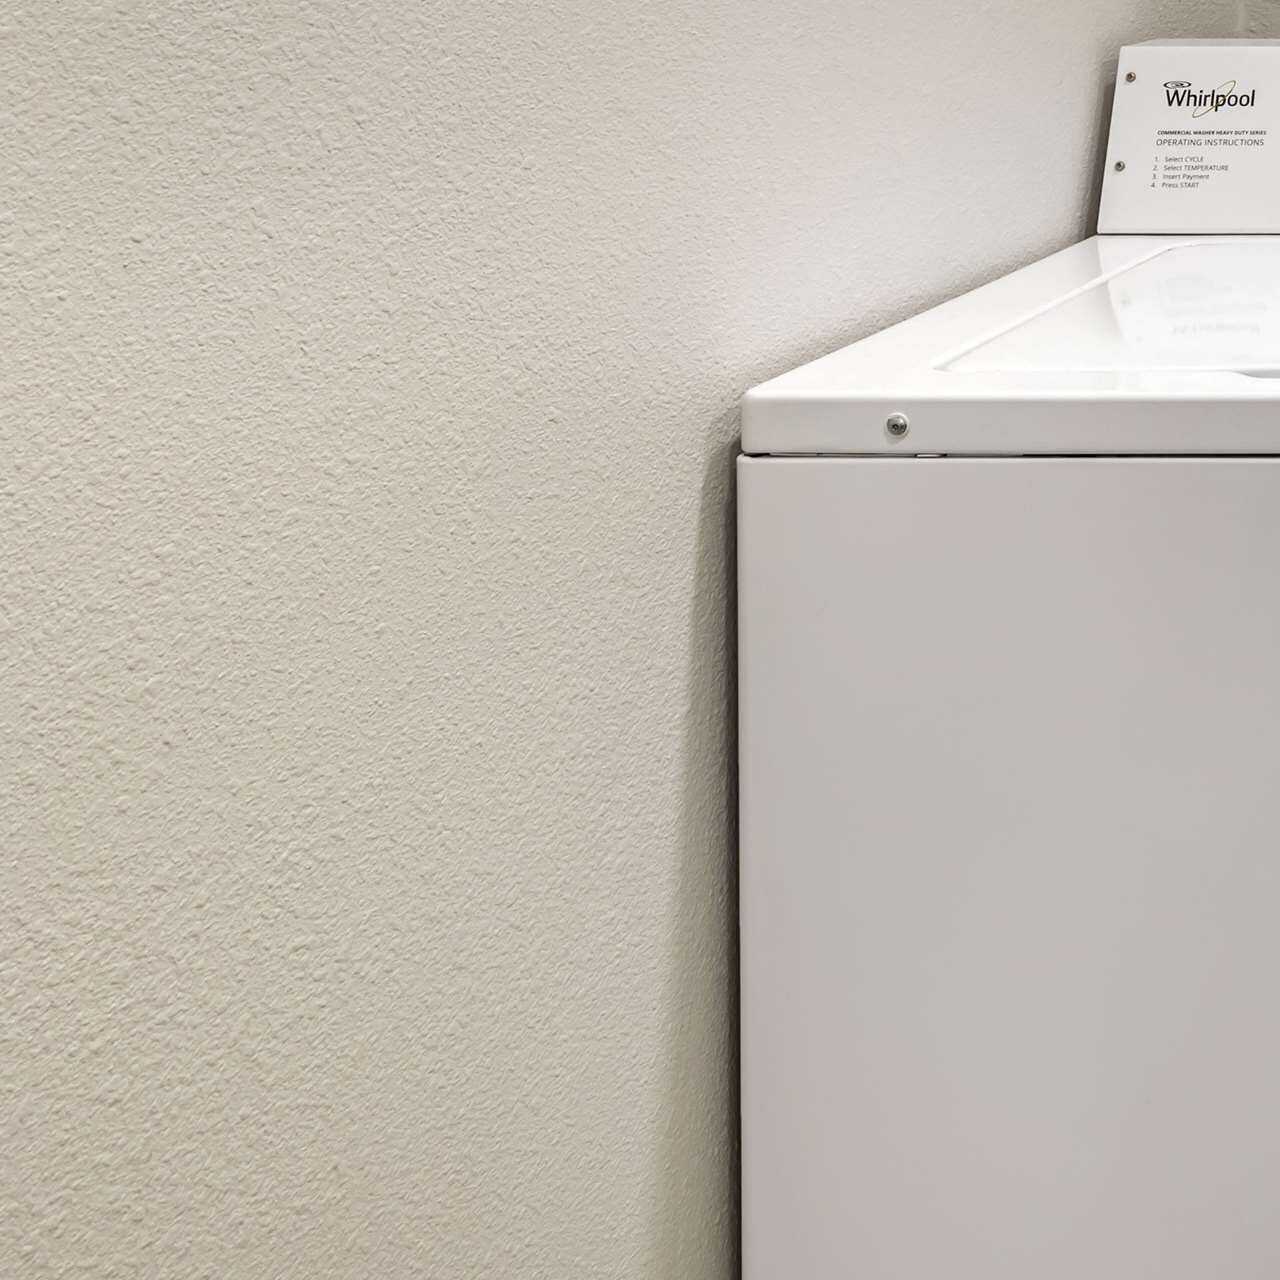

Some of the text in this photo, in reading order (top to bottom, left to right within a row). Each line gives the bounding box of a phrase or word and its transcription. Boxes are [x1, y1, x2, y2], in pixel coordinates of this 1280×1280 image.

[1166, 89, 1255, 112] Whirlpool
[1155, 138, 1265, 147] OPERATING INSTRUCTIONS
